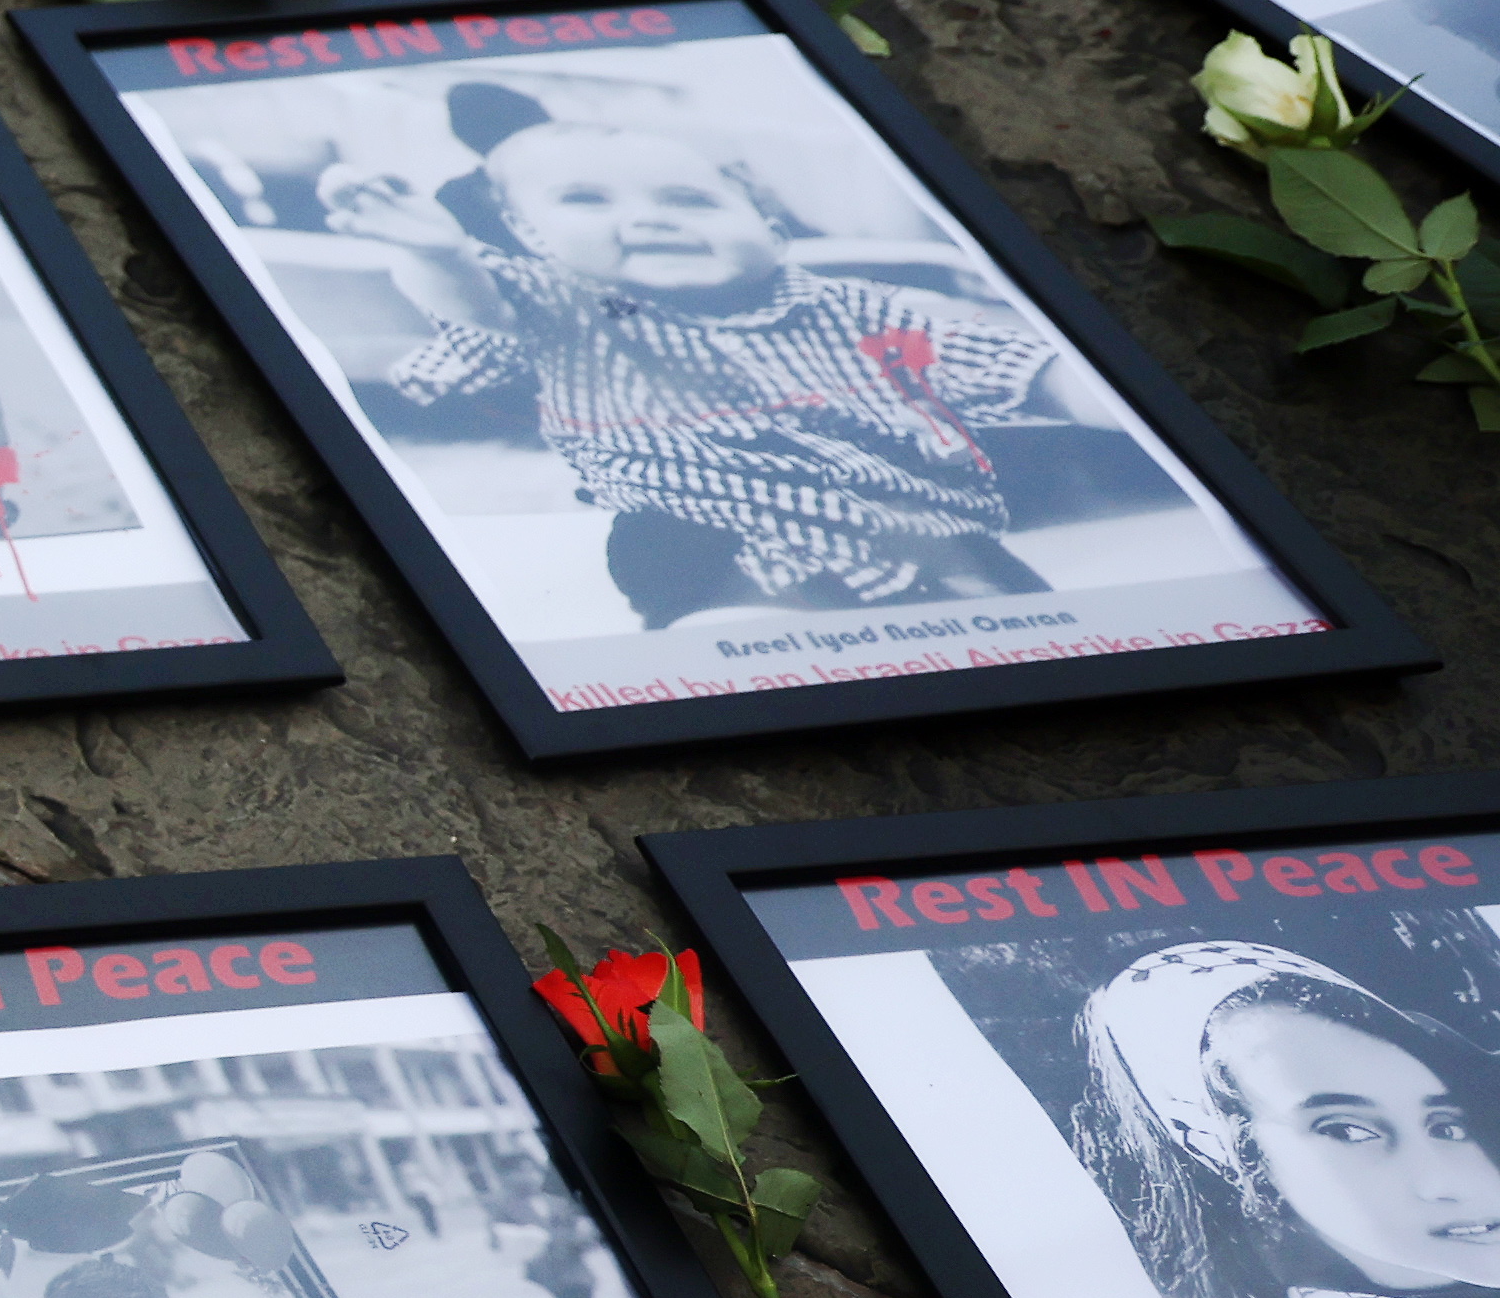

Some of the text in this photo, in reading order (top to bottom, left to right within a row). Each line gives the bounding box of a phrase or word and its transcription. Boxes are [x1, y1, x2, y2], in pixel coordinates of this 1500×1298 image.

[167, 10, 674, 74] Rest IN Peace
[805, 626, 879, 653] Iyad
[883, 619, 968, 641] Nabil
[971, 612, 1078, 632] Omran
[547, 619, 1337, 711] killed by an Israeli Airstrike in Gaza
[835, 847, 1477, 929] Rest IN Peace
[24, 942, 315, 1005] Peace
